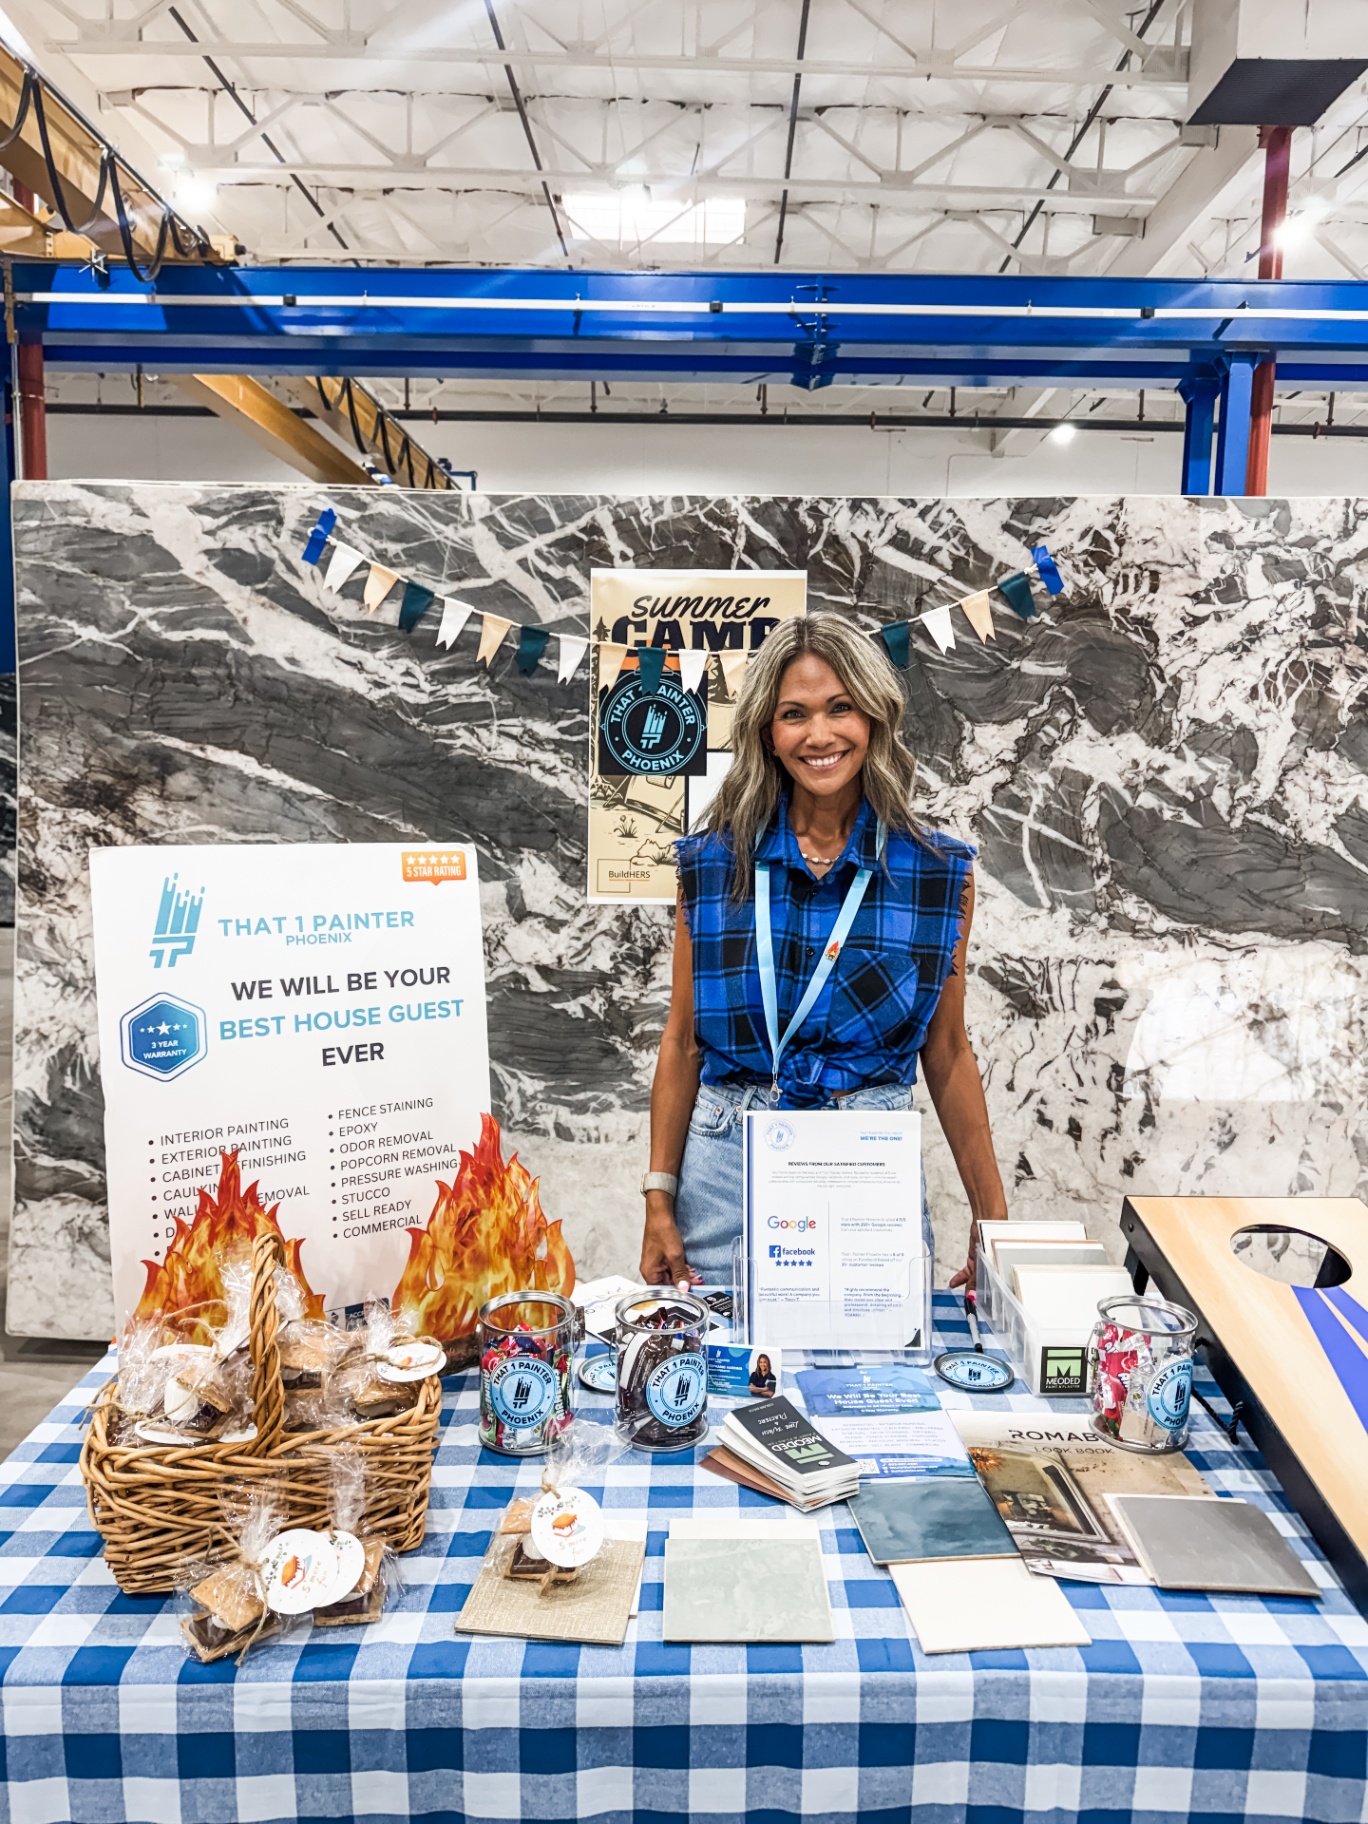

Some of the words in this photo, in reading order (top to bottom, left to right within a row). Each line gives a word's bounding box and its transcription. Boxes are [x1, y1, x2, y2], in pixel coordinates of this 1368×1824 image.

[610, 690, 636, 723] THAT
[657, 686, 696, 724] AINTER
[622, 749, 684, 771] PHOENIX
[406, 866, 412, 877] 5
[413, 866, 432, 877] STAR
[434, 865, 462, 876] RATING
[609, 870, 650, 879] BuildHERS
[218, 917, 286, 937] THAT
[295, 916, 304, 932] 1
[313, 911, 415, 932] PAINTER
[286, 932, 352, 946] PHOENIX
[231, 980, 272, 1000] WE
[280, 975, 340, 997] WILL
[347, 972, 378, 991] BE
[384, 966, 451, 988] YOUR
[220, 1015, 286, 1040] BEST
[294, 1006, 381, 1033] HOUSE
[388, 999, 464, 1023] GUEST
[143, 1048, 188, 1060] WARRANTY
[159, 1040, 178, 1048] YEAR
[322, 1042, 384, 1066] EVER
[338, 1105, 376, 1120] FENCE
[380, 1098, 434, 1114] STAINING
[160, 1128, 224, 1146] INTERIOR
[228, 1118, 288, 1136] PAINTING
[339, 1122, 378, 1137] EPOXY
[162, 1146, 226, 1164] EXTERIOR
[230, 1136, 292, 1154] PAINTING
[340, 1140, 376, 1154] ODOR
[379, 1131, 434, 1149] REMOVAL
[162, 1164, 220, 1182] CABINET
[238, 1150, 306, 1170] FINISHING
[340, 1152, 399, 1171] POPCORN
[402, 1144, 456, 1162] REMOVAL
[341, 1168, 402, 1188] PRESSURE
[404, 1159, 458, 1178] WASHING
[258, 1186, 310, 1204] EMOVAL
[342, 1187, 390, 1205] STUCCO
[342, 1208, 370, 1223] SELL
[374, 1200, 412, 1218] READY
[343, 1215, 422, 1240] COMMERCIAL
[767, 1216, 816, 1232] Google
[782, 1248, 816, 1256] facebook
[493, 1367, 510, 1385] THAT
[518, 1362, 551, 1385] PAINTER
[652, 1365, 670, 1387] THAT
[680, 1358, 704, 1376] PAINTER
[946, 1362, 959, 1371] THAT
[967, 1361, 1000, 1374] PAINTER
[1152, 1374, 1168, 1396] THAT
[501, 1408, 544, 1425] PHOENIX
[662, 1402, 700, 1421] PHOENIX
[771, 1435, 822, 1452] MEODED
[1008, 1429, 1099, 1442] ROMAB
